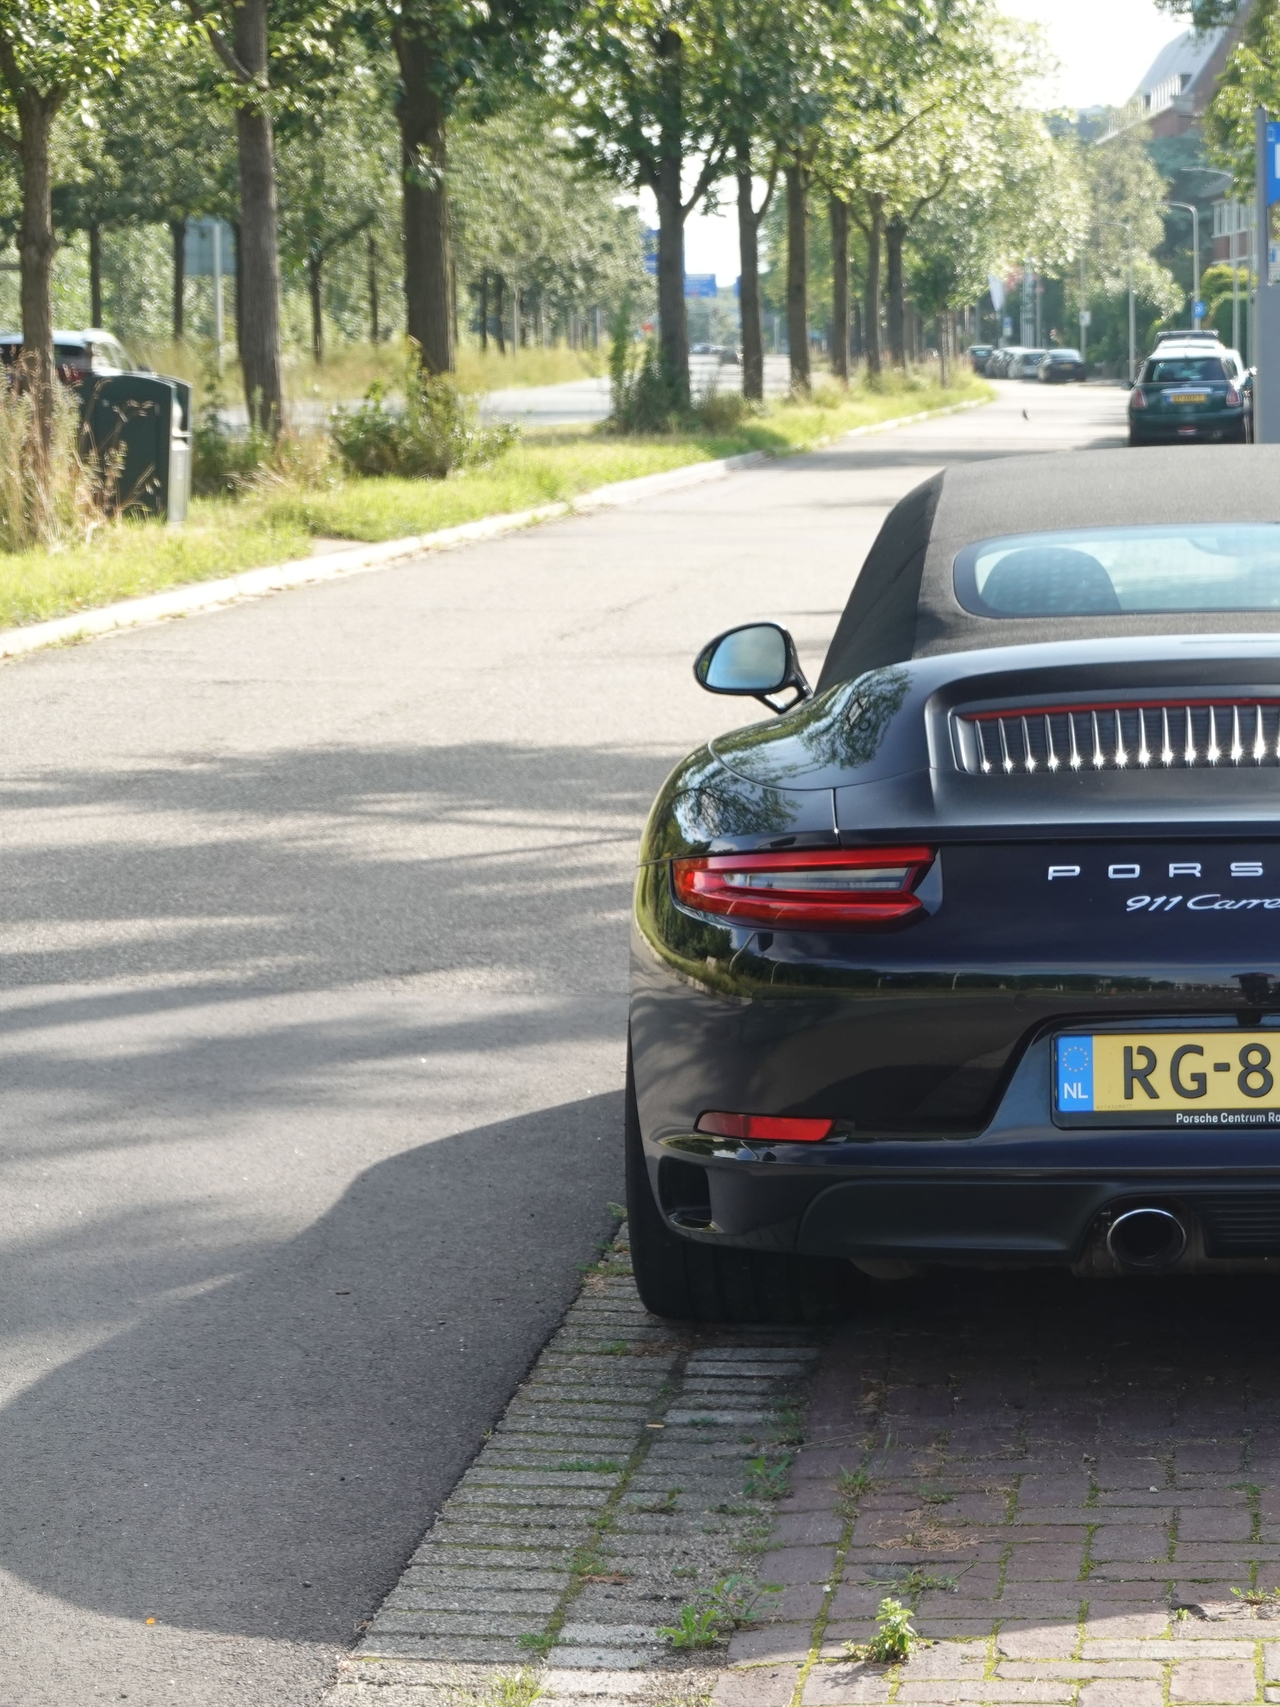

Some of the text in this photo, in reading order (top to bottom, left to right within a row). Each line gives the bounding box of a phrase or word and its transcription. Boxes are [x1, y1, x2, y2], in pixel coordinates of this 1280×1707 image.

[1126, 895, 1183, 912] 911
[1063, 1082, 1088, 1100] NL
[1176, 1113, 1218, 1123] Porsche
[1220, 1112, 1266, 1123] Centrum
